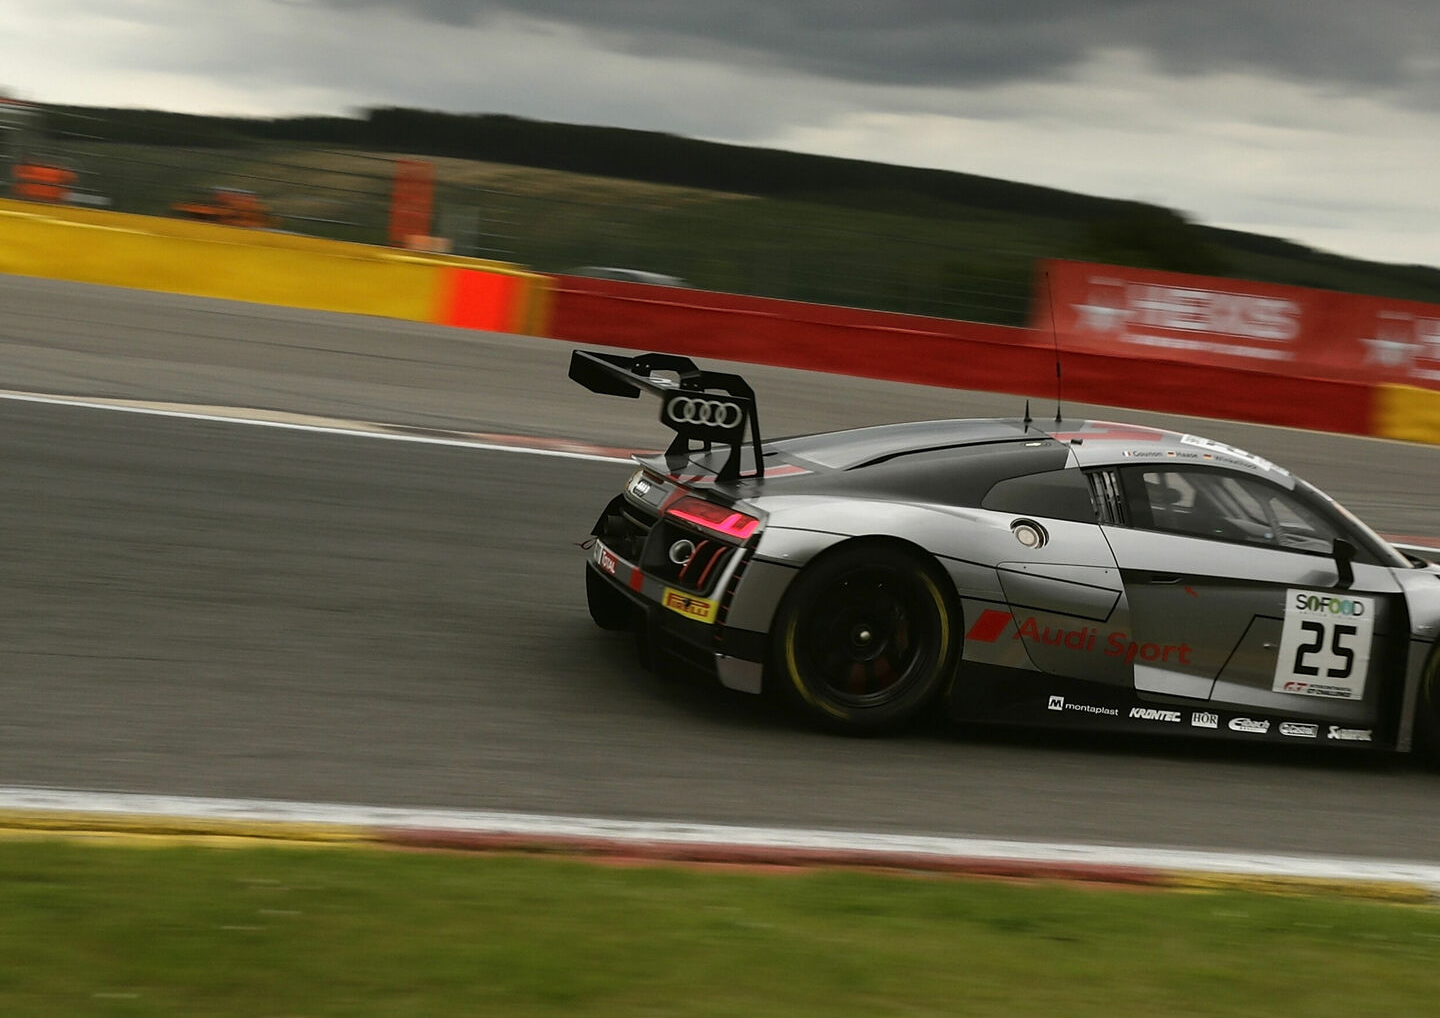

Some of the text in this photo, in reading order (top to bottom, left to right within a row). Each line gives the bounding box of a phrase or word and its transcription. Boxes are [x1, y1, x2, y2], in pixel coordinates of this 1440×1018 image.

[601, 550, 616, 575] TOTAL
[666, 592, 711, 618] PIRELLI
[1295, 593, 1365, 617] SOFOOD
[1012, 616, 1193, 666] Audi Sport
[1292, 620, 1357, 679] 25
[1065, 702, 1119, 716] montaplast
[1129, 707, 1182, 722] KRONTEC
